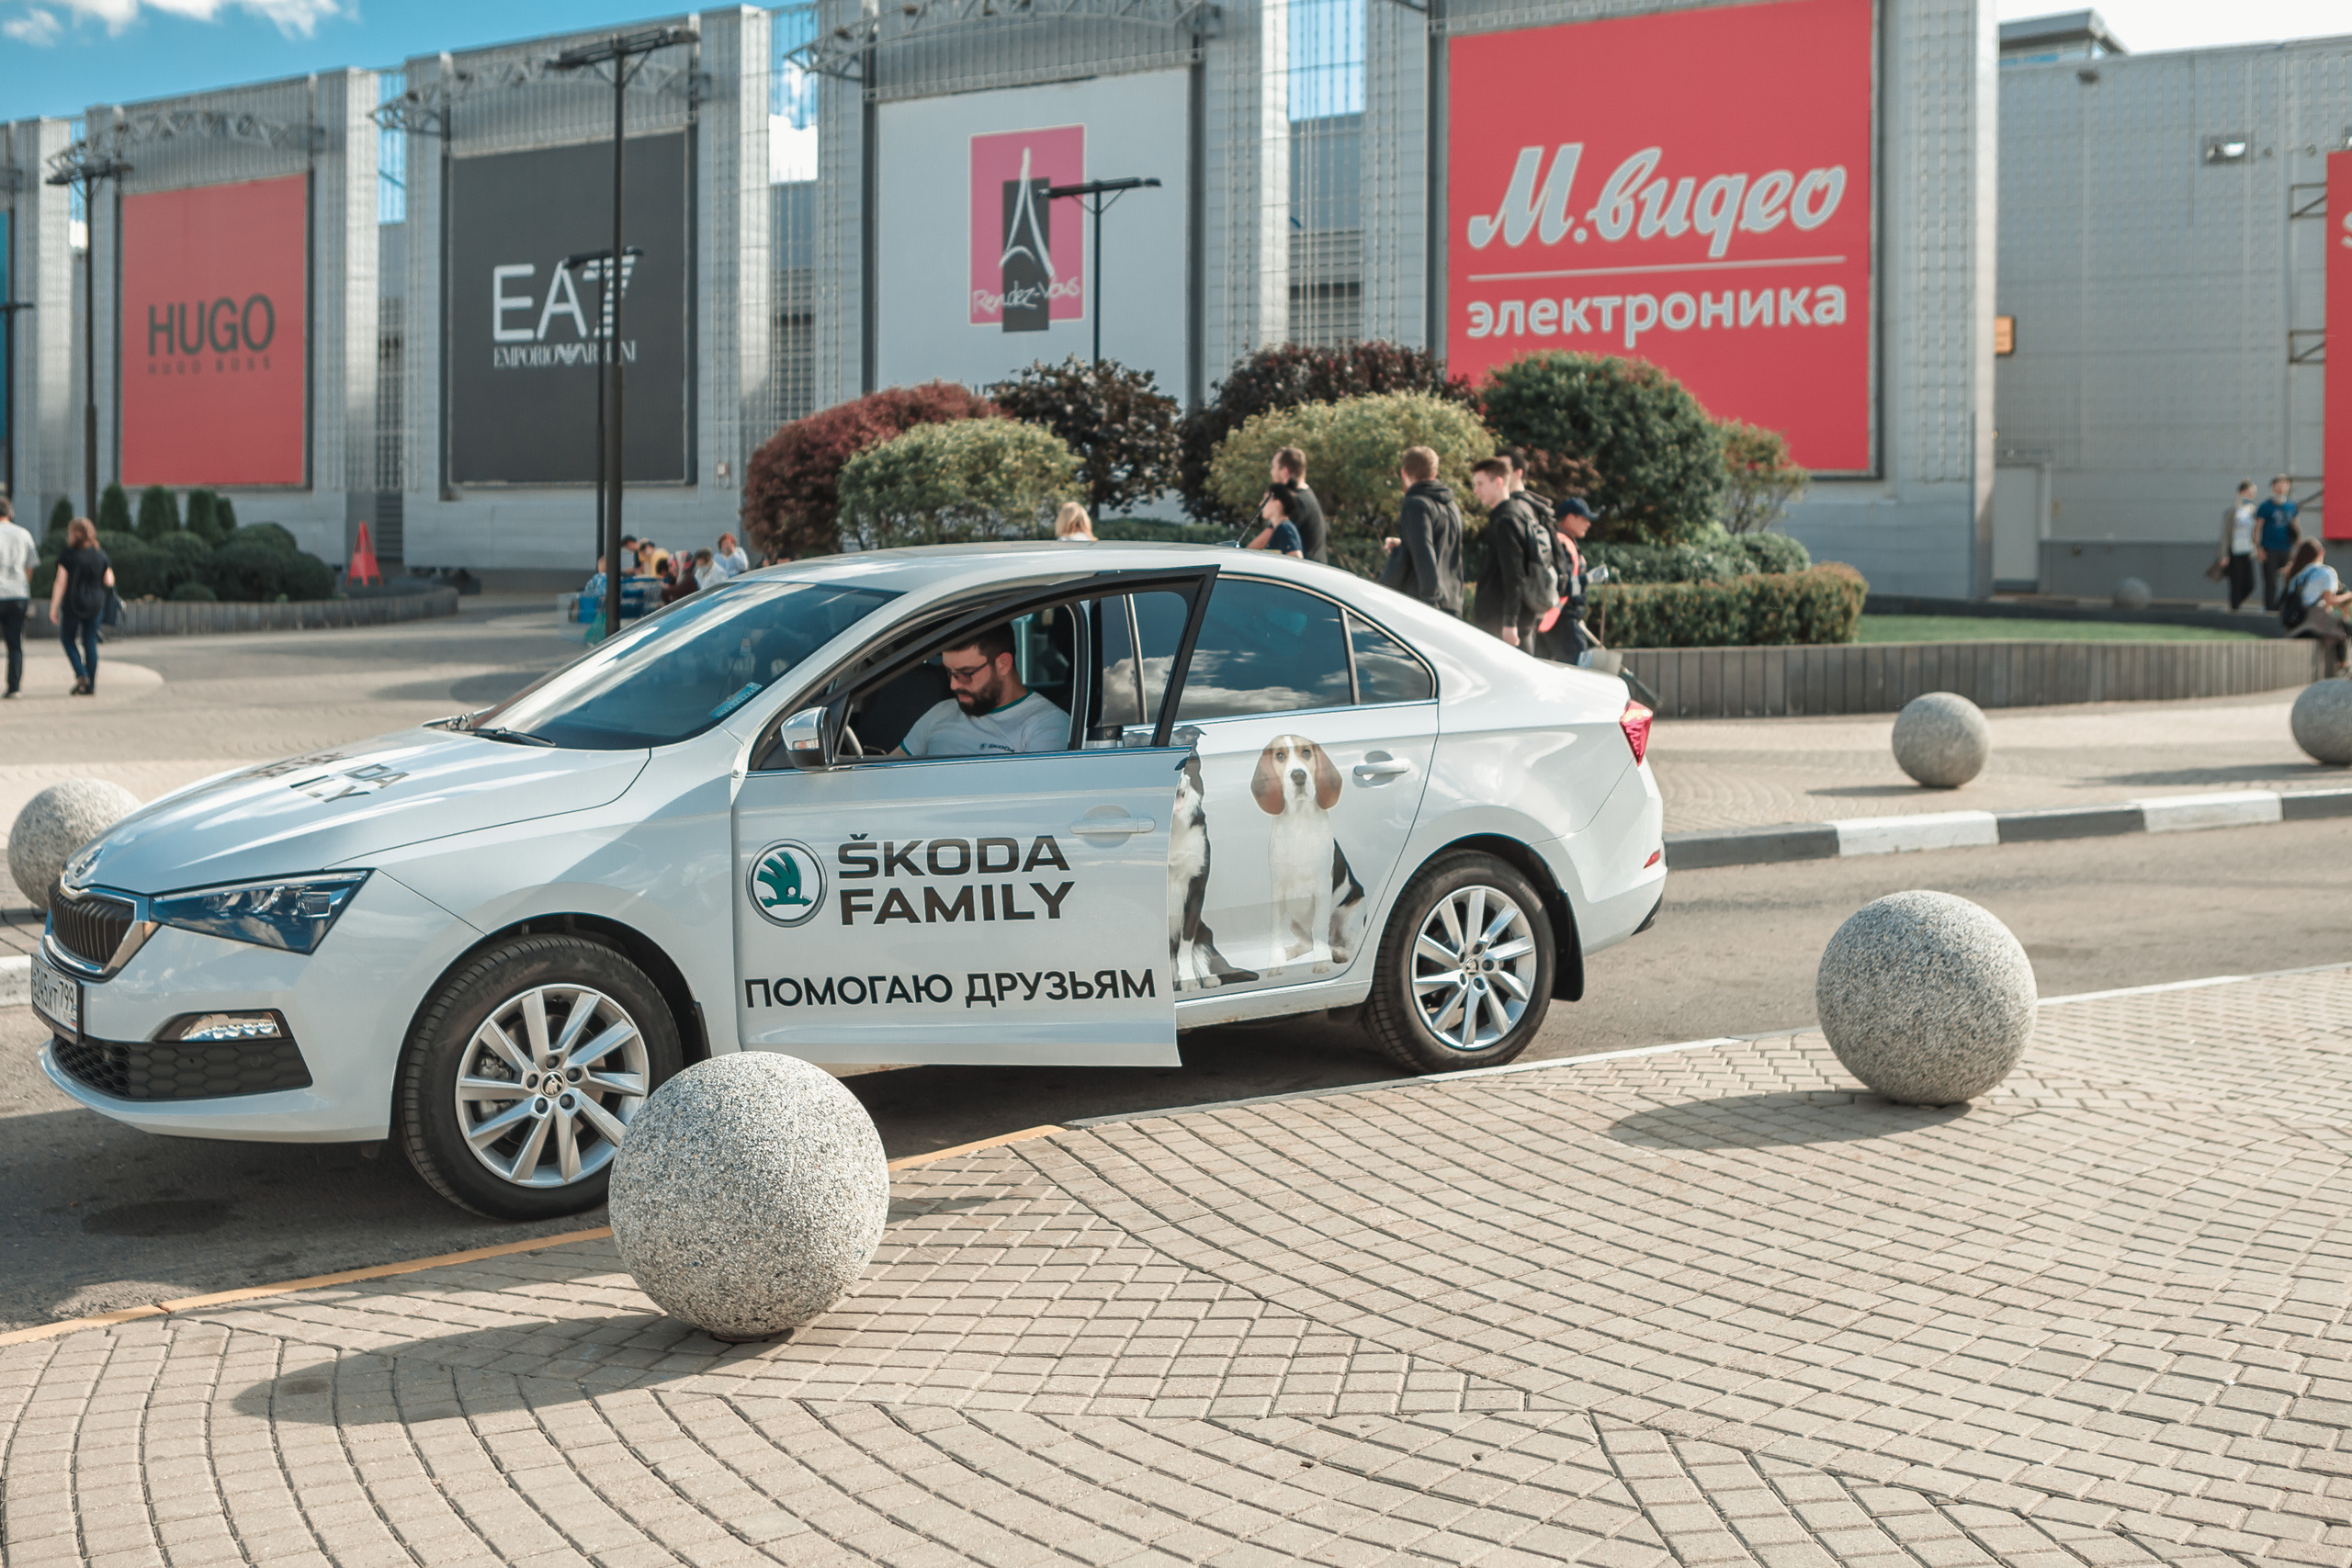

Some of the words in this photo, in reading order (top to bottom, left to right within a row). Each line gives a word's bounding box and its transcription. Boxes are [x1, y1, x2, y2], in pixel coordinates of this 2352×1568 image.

[493, 254, 636, 342] EA7
[1467, 285, 1847, 348] электроника
[148, 293, 275, 356] HUGO
[493, 344, 560, 367] EMPORIO
[838, 834, 1070, 878] ŠKODA
[840, 882, 1075, 926] FAMILY
[744, 975, 953, 1009] ПОМОГАЮ
[965, 968, 1157, 1008] ДРУЗЬЯМ
